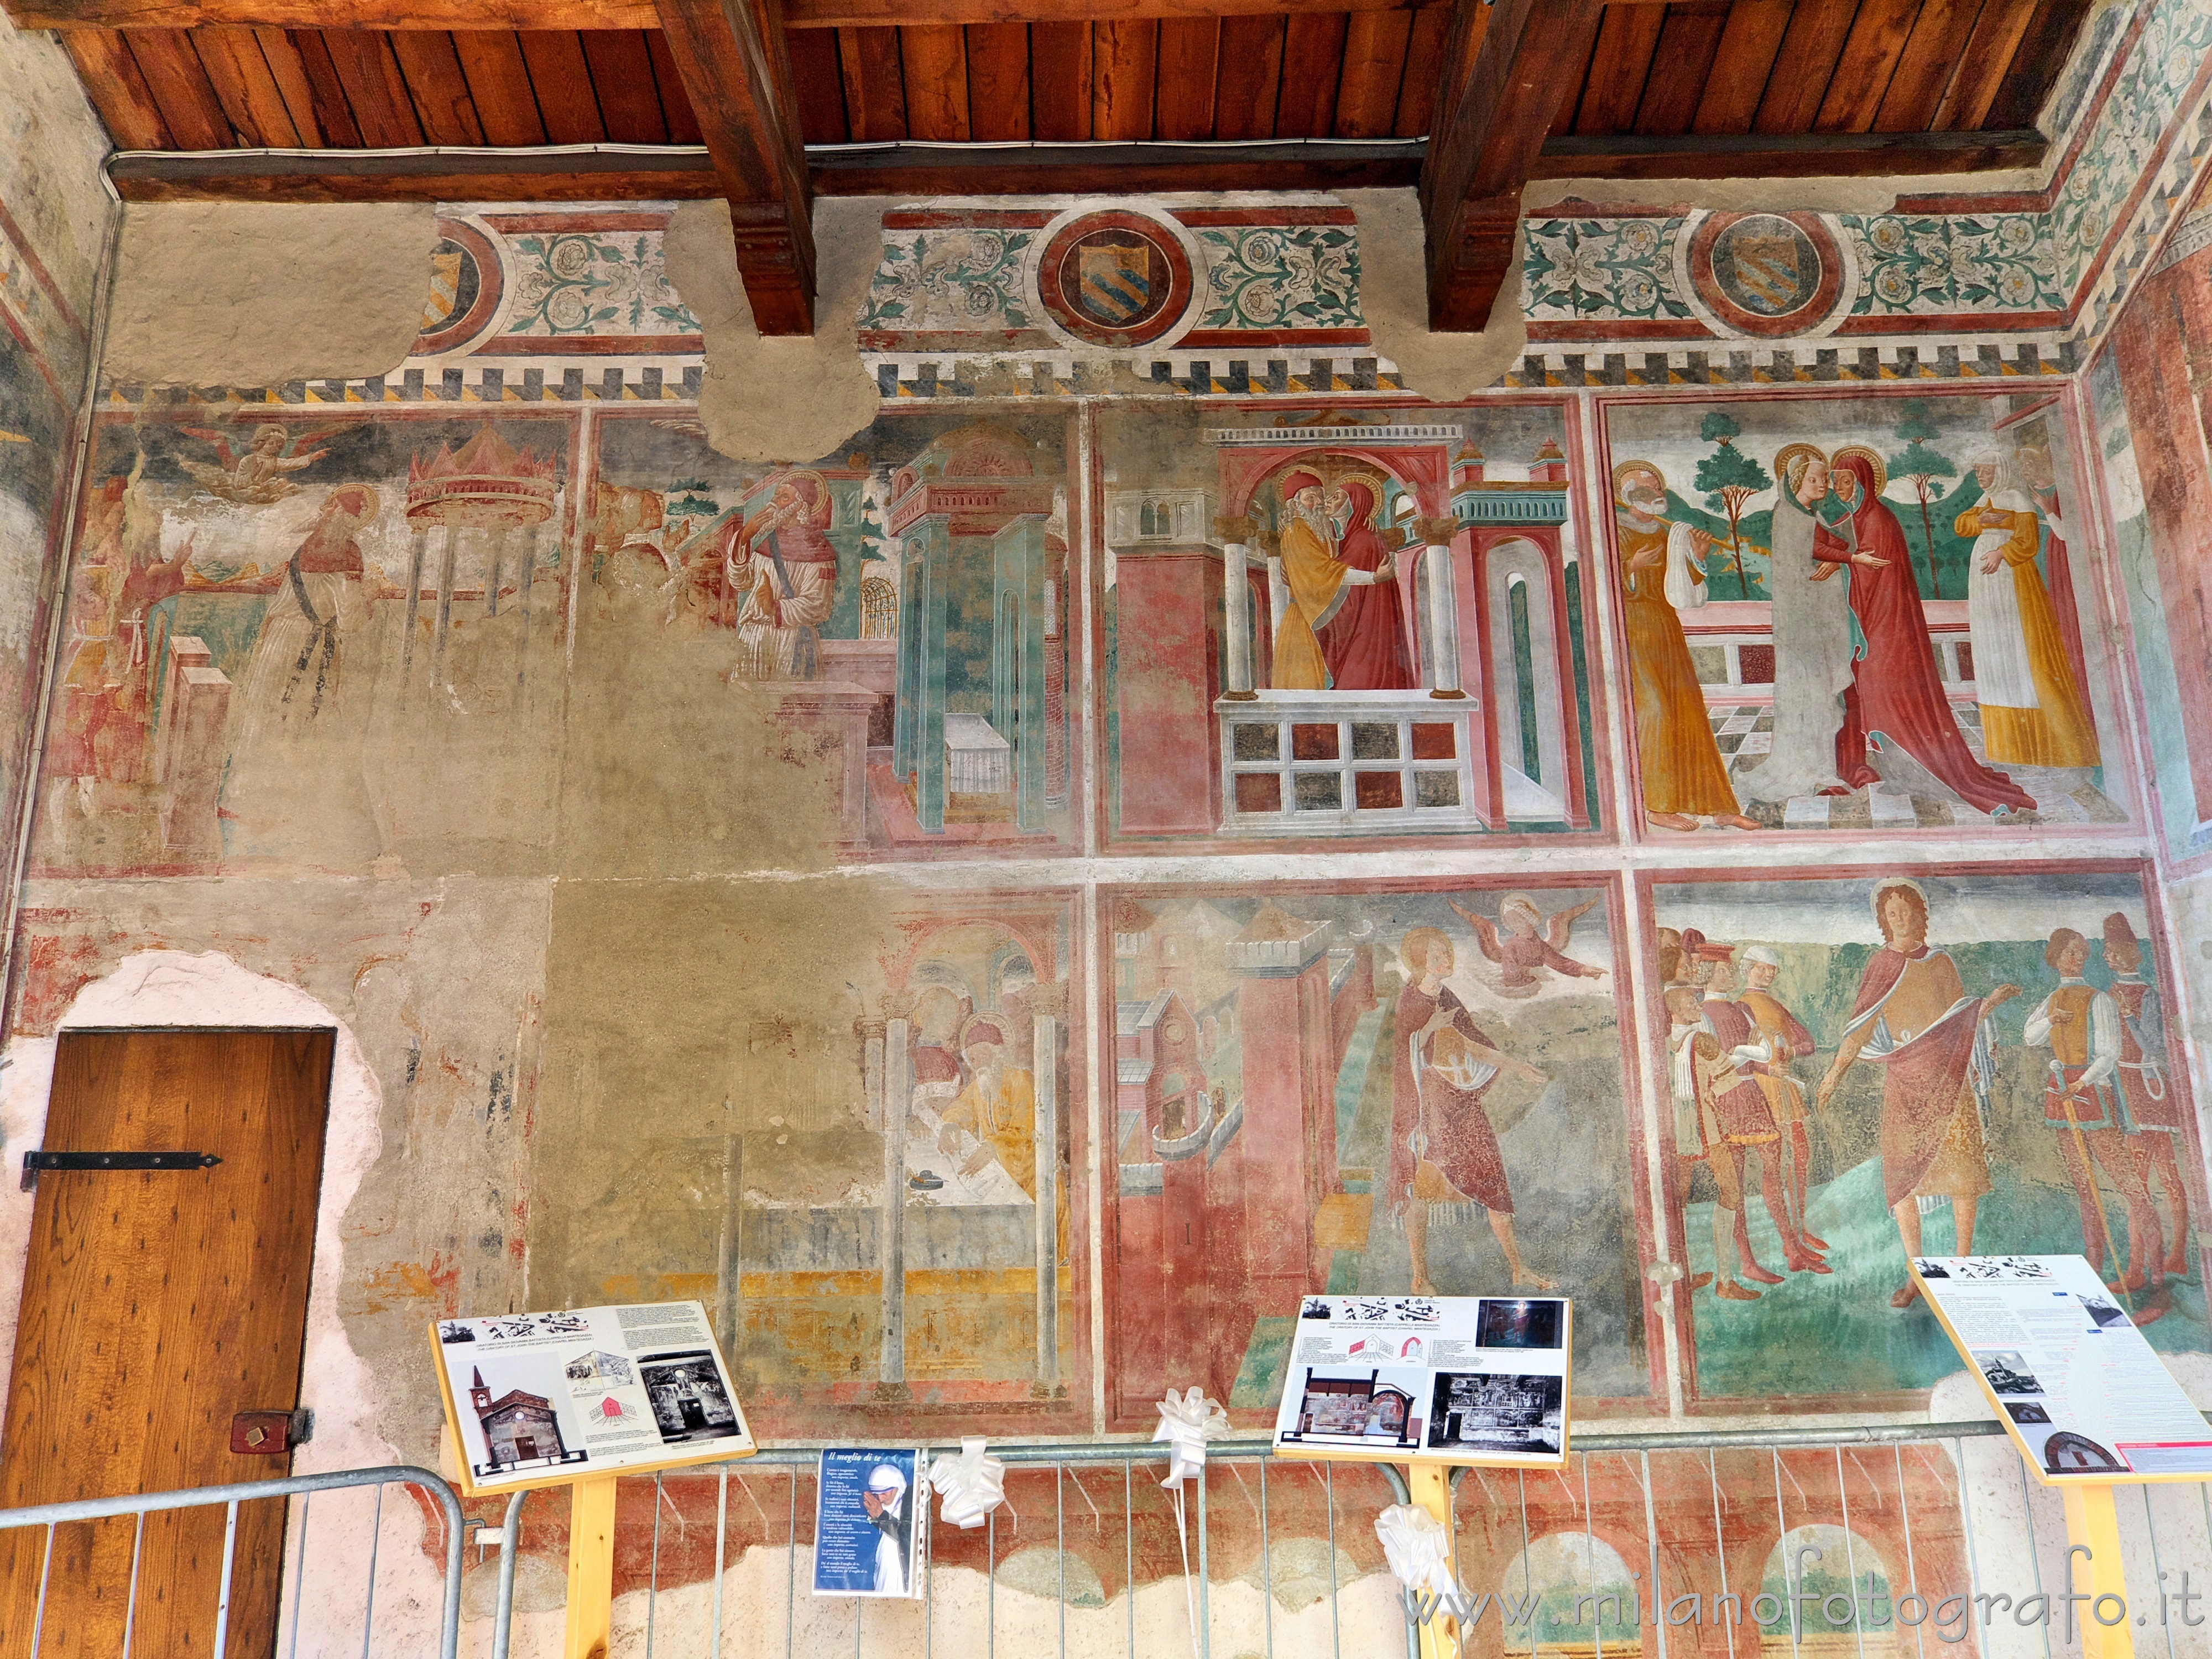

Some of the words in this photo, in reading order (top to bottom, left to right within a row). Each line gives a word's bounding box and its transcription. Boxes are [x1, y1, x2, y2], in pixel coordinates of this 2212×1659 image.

[828, 1452, 836, 1460] Il
[837, 1452, 862, 1463] meglio
[863, 1453, 873, 1461] di
